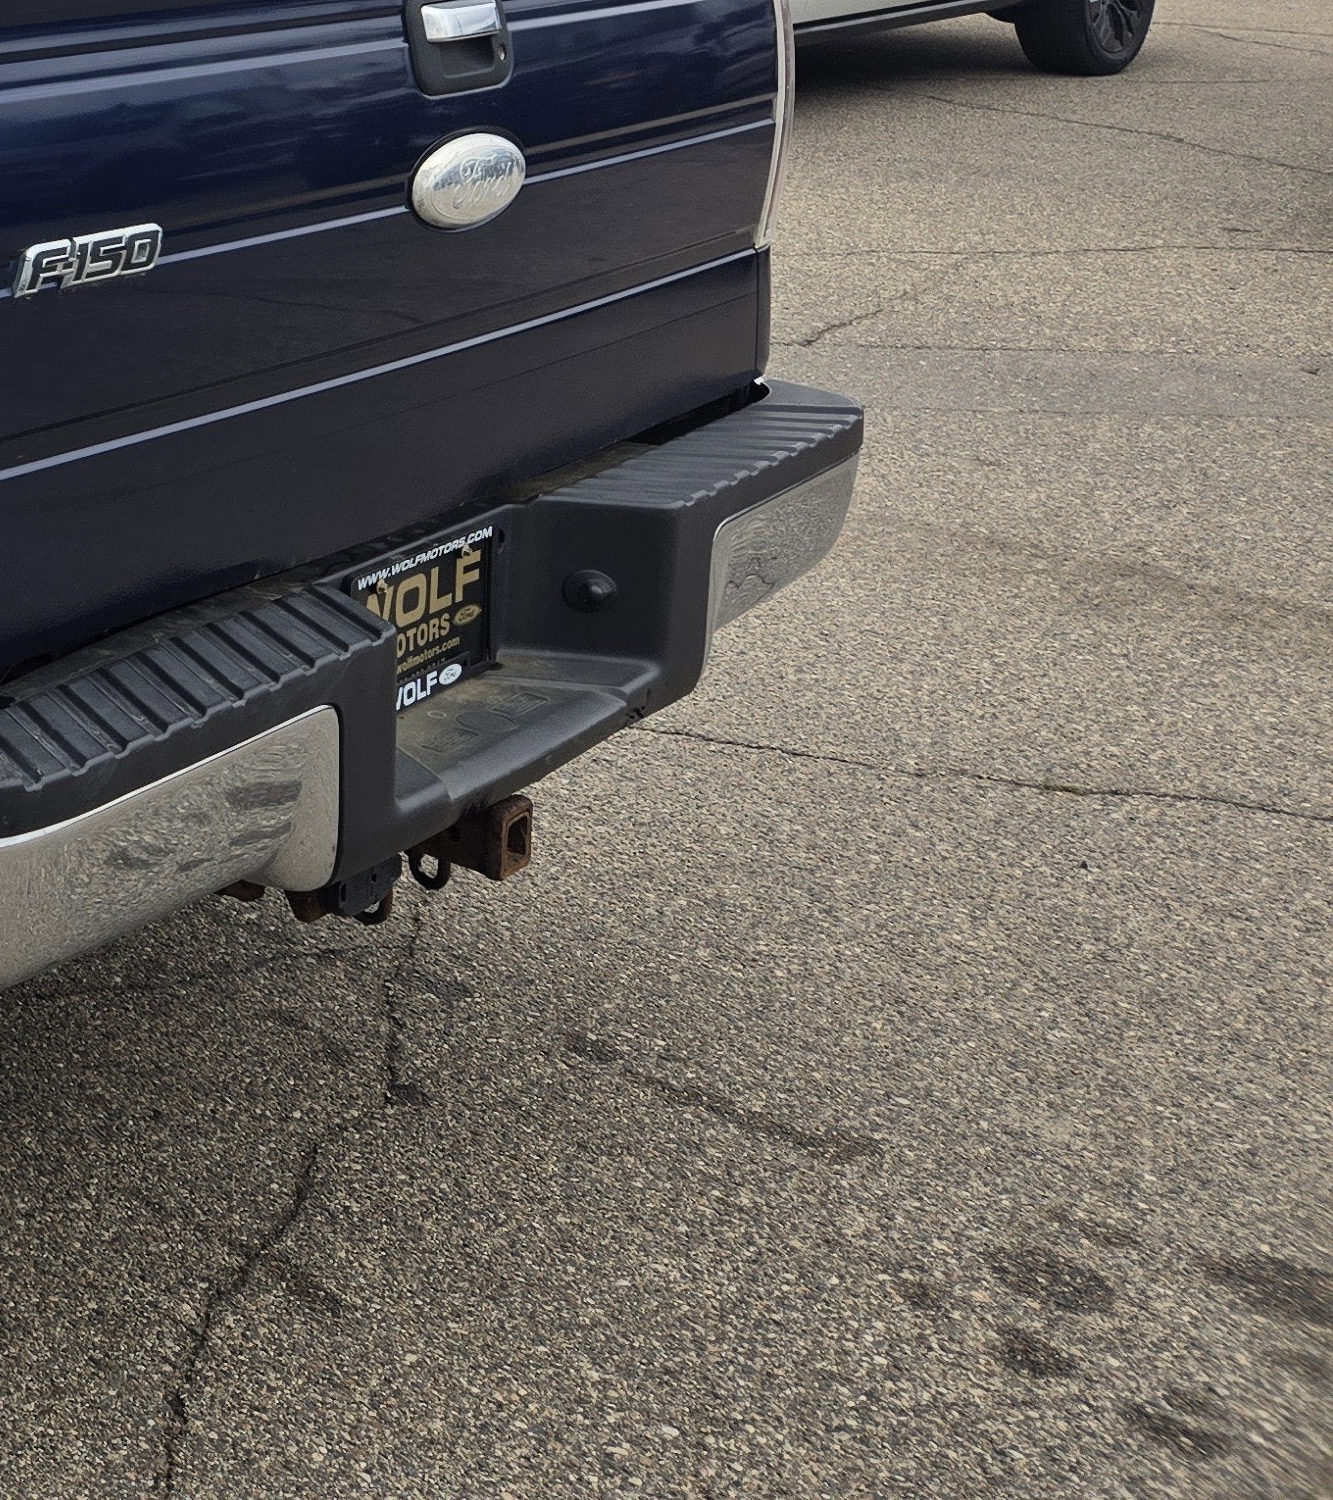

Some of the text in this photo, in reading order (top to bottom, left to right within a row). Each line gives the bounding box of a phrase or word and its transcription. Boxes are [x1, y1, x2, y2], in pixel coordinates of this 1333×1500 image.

[452, 153, 513, 210] Ford
[14, 222, 163, 298] F-150
[357, 526, 493, 591] WWW.WOLFMOTORS.COM
[396, 613, 451, 659] OTORS
[396, 670, 438, 711] OLF
